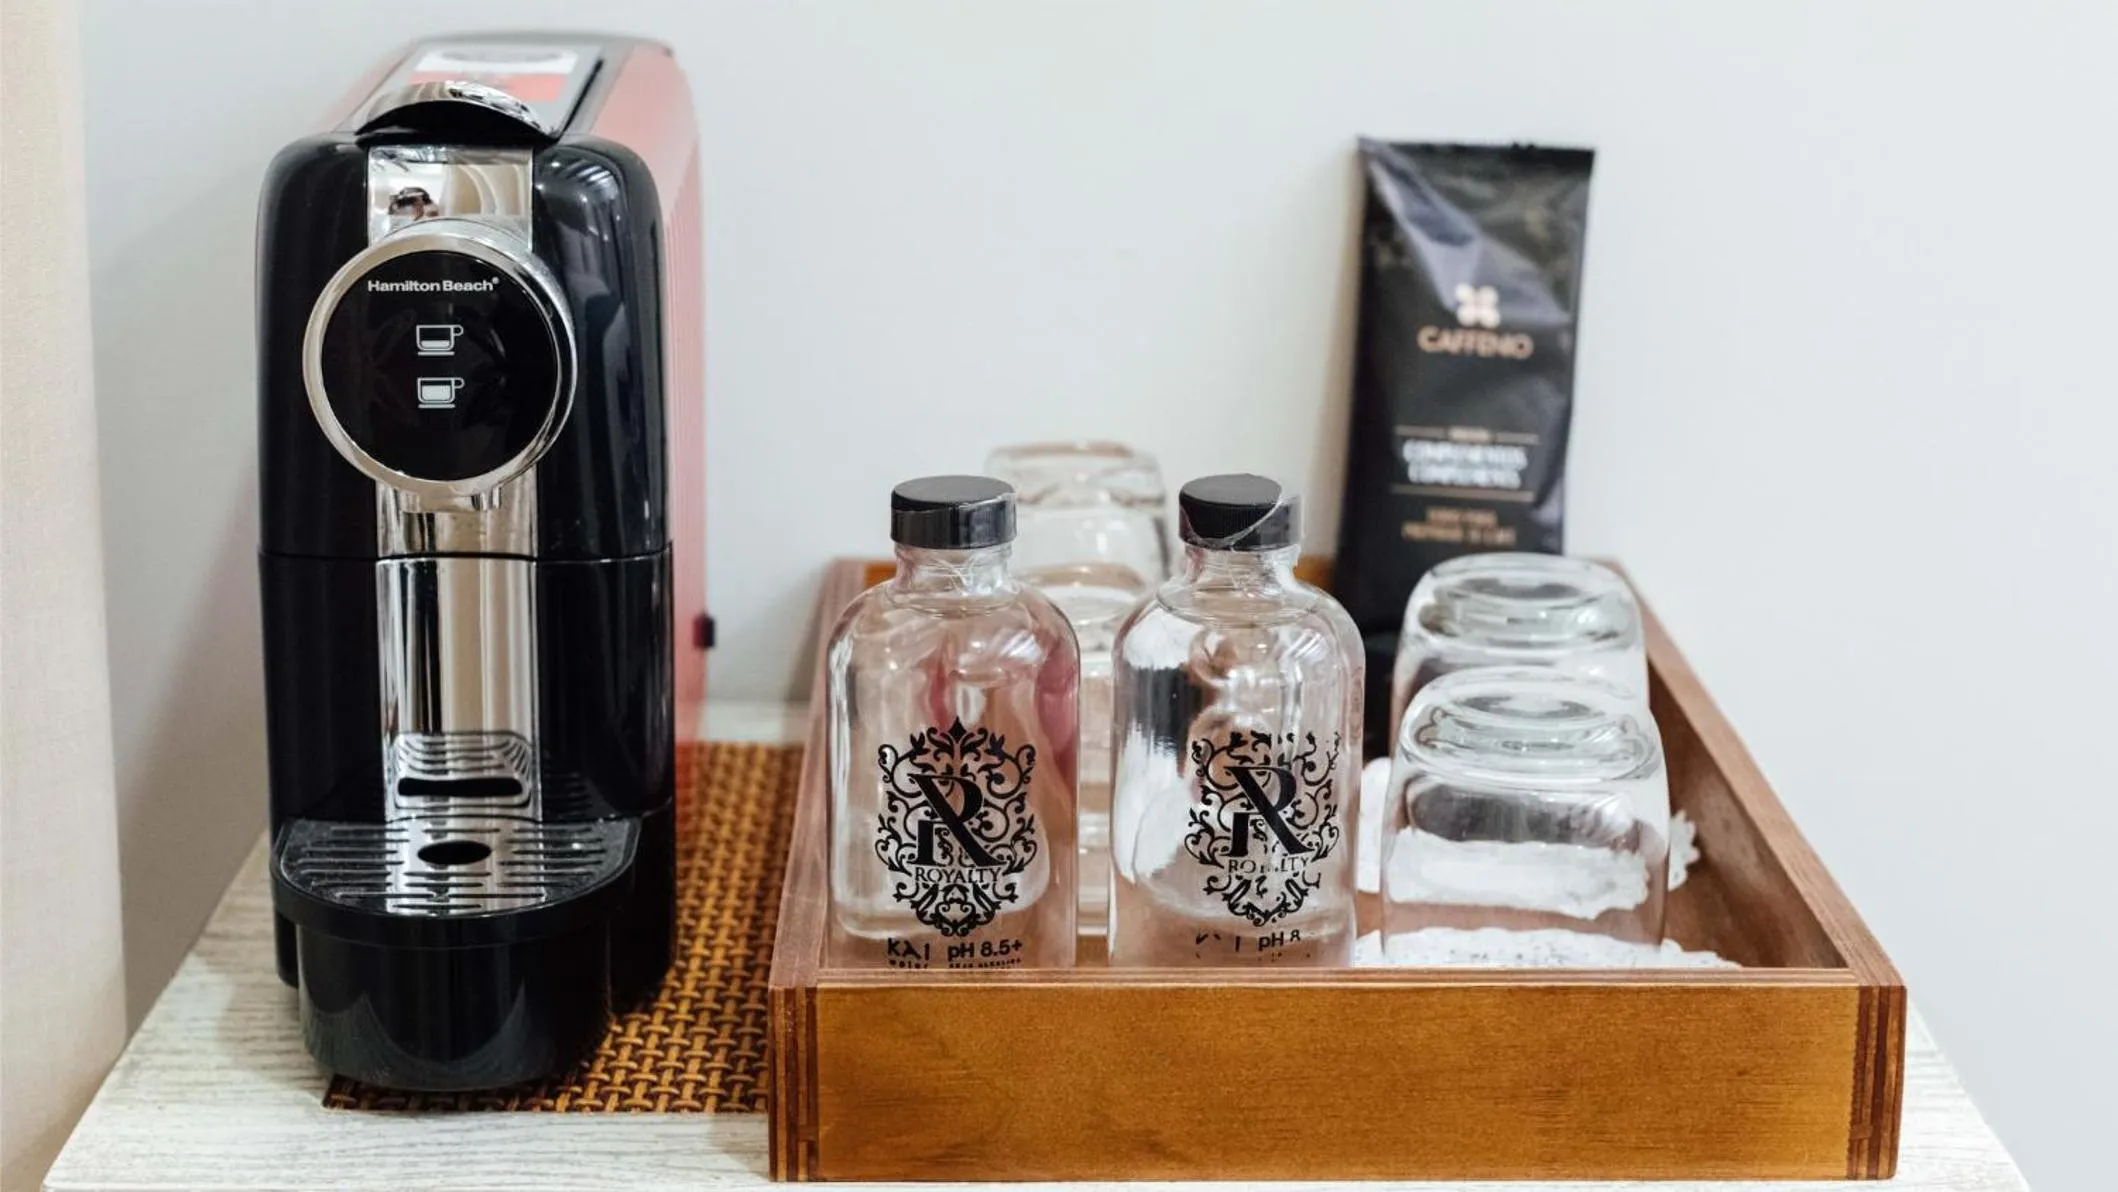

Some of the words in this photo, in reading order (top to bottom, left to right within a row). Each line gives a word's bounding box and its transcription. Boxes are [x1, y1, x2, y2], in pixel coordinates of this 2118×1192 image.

[367, 279, 441, 292] Hamilton
[914, 866, 1002, 884] ROYALTY
[947, 942, 975, 962] pH
[980, 938, 1023, 958] 8.5+
[1258, 931, 1285, 952] pH
